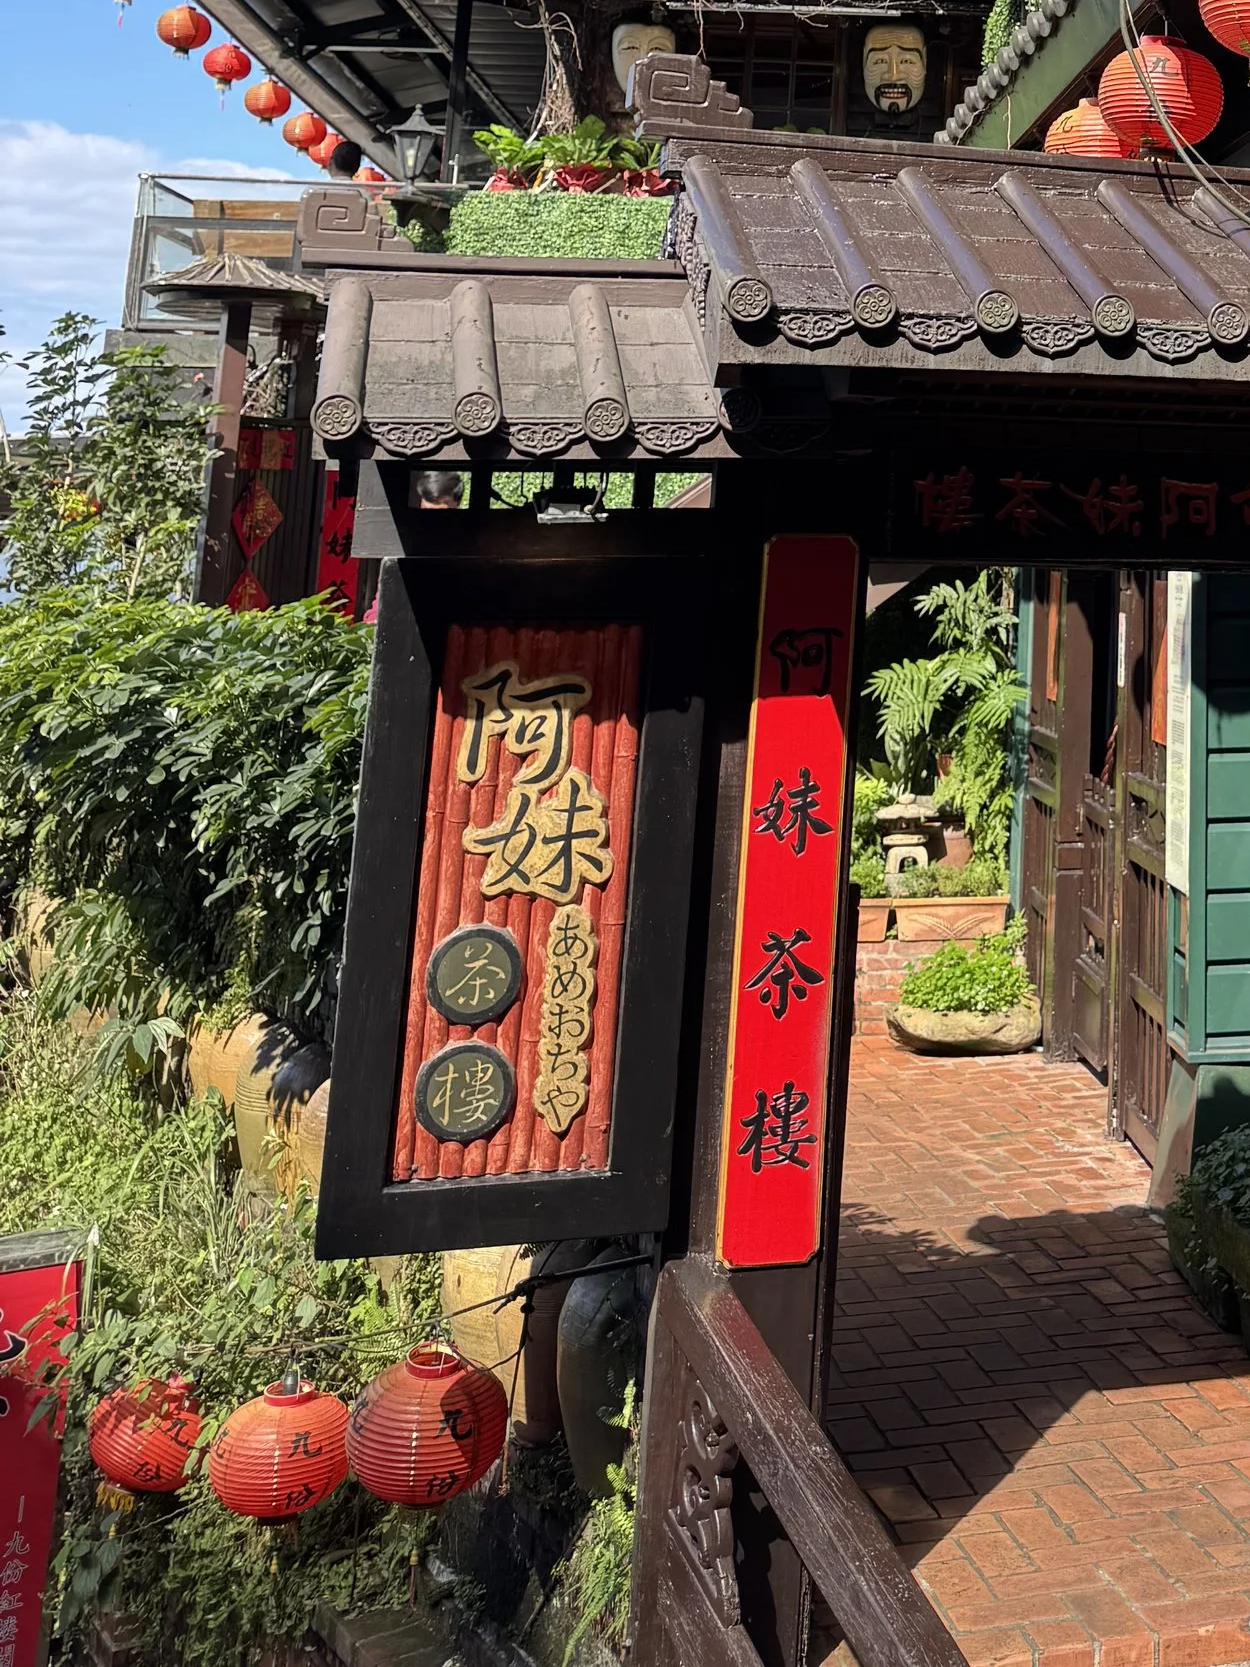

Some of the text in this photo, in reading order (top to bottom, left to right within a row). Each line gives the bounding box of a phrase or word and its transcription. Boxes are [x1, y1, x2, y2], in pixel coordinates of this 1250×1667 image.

[468, 667, 607, 893] 阿妹
[738, 626, 844, 1174] 阿妹茶樓
[431, 942, 506, 1125] 茶樓
[284, 1430, 323, 1511] 九份
[425, 1407, 473, 1499] 九份
